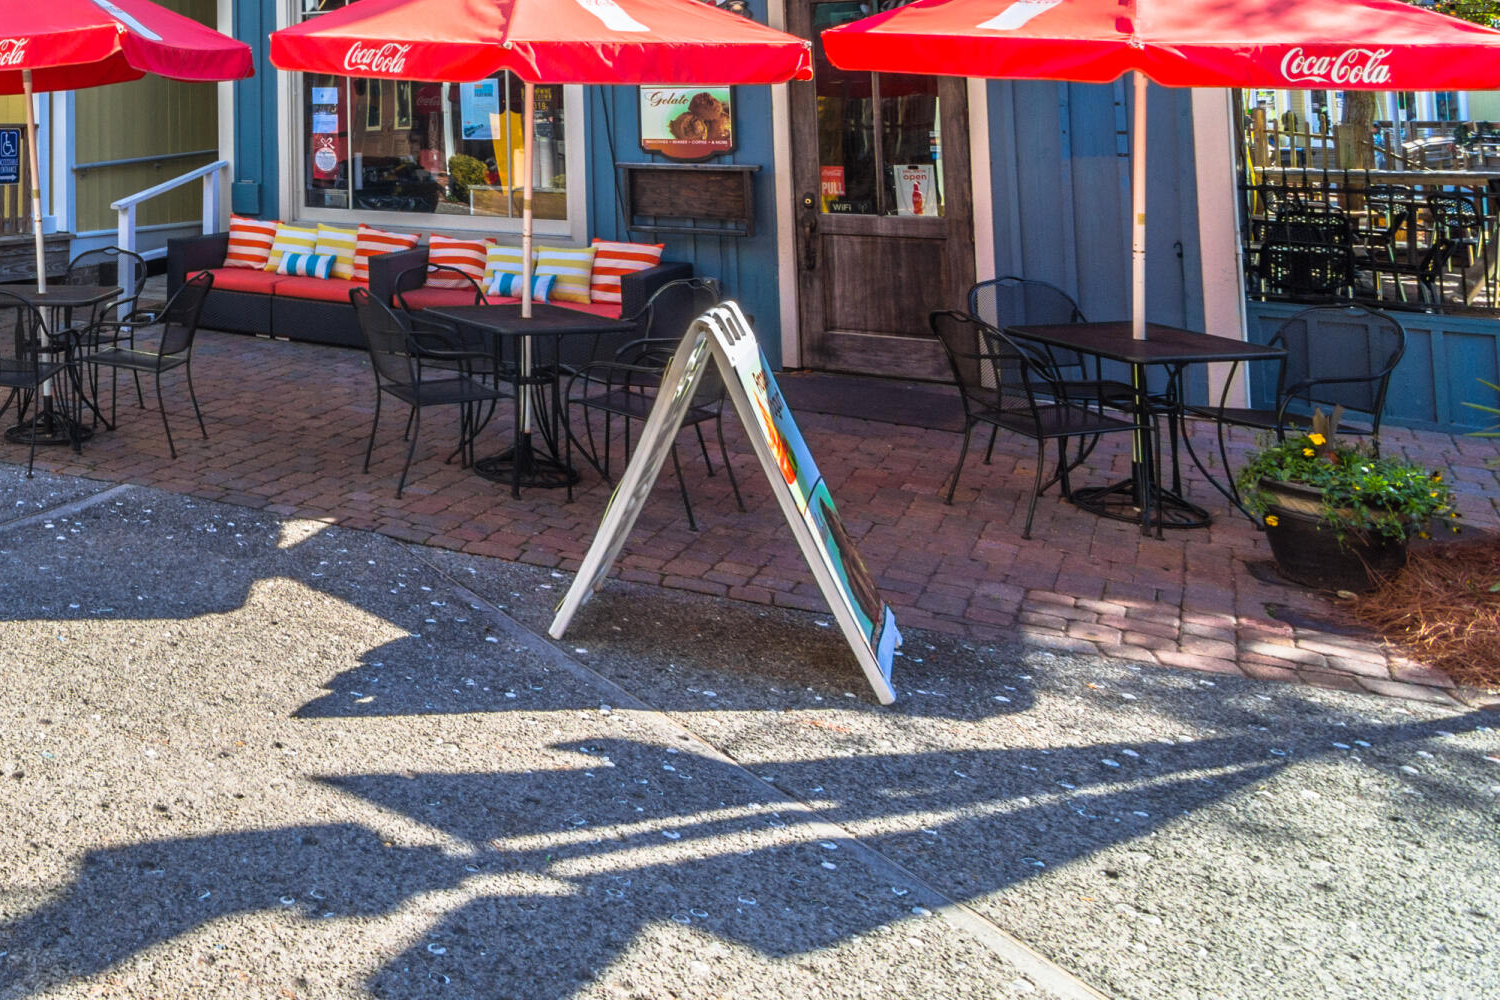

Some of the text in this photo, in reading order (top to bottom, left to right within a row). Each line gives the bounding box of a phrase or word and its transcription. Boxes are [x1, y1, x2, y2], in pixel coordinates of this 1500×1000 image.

[344, 41, 412, 73] Coca-Cola
[1281, 47, 1393, 84] Coca-Cola
[645, 91, 689, 107] Gelato
[903, 174, 927, 182] open
[822, 181, 844, 194] PULL
